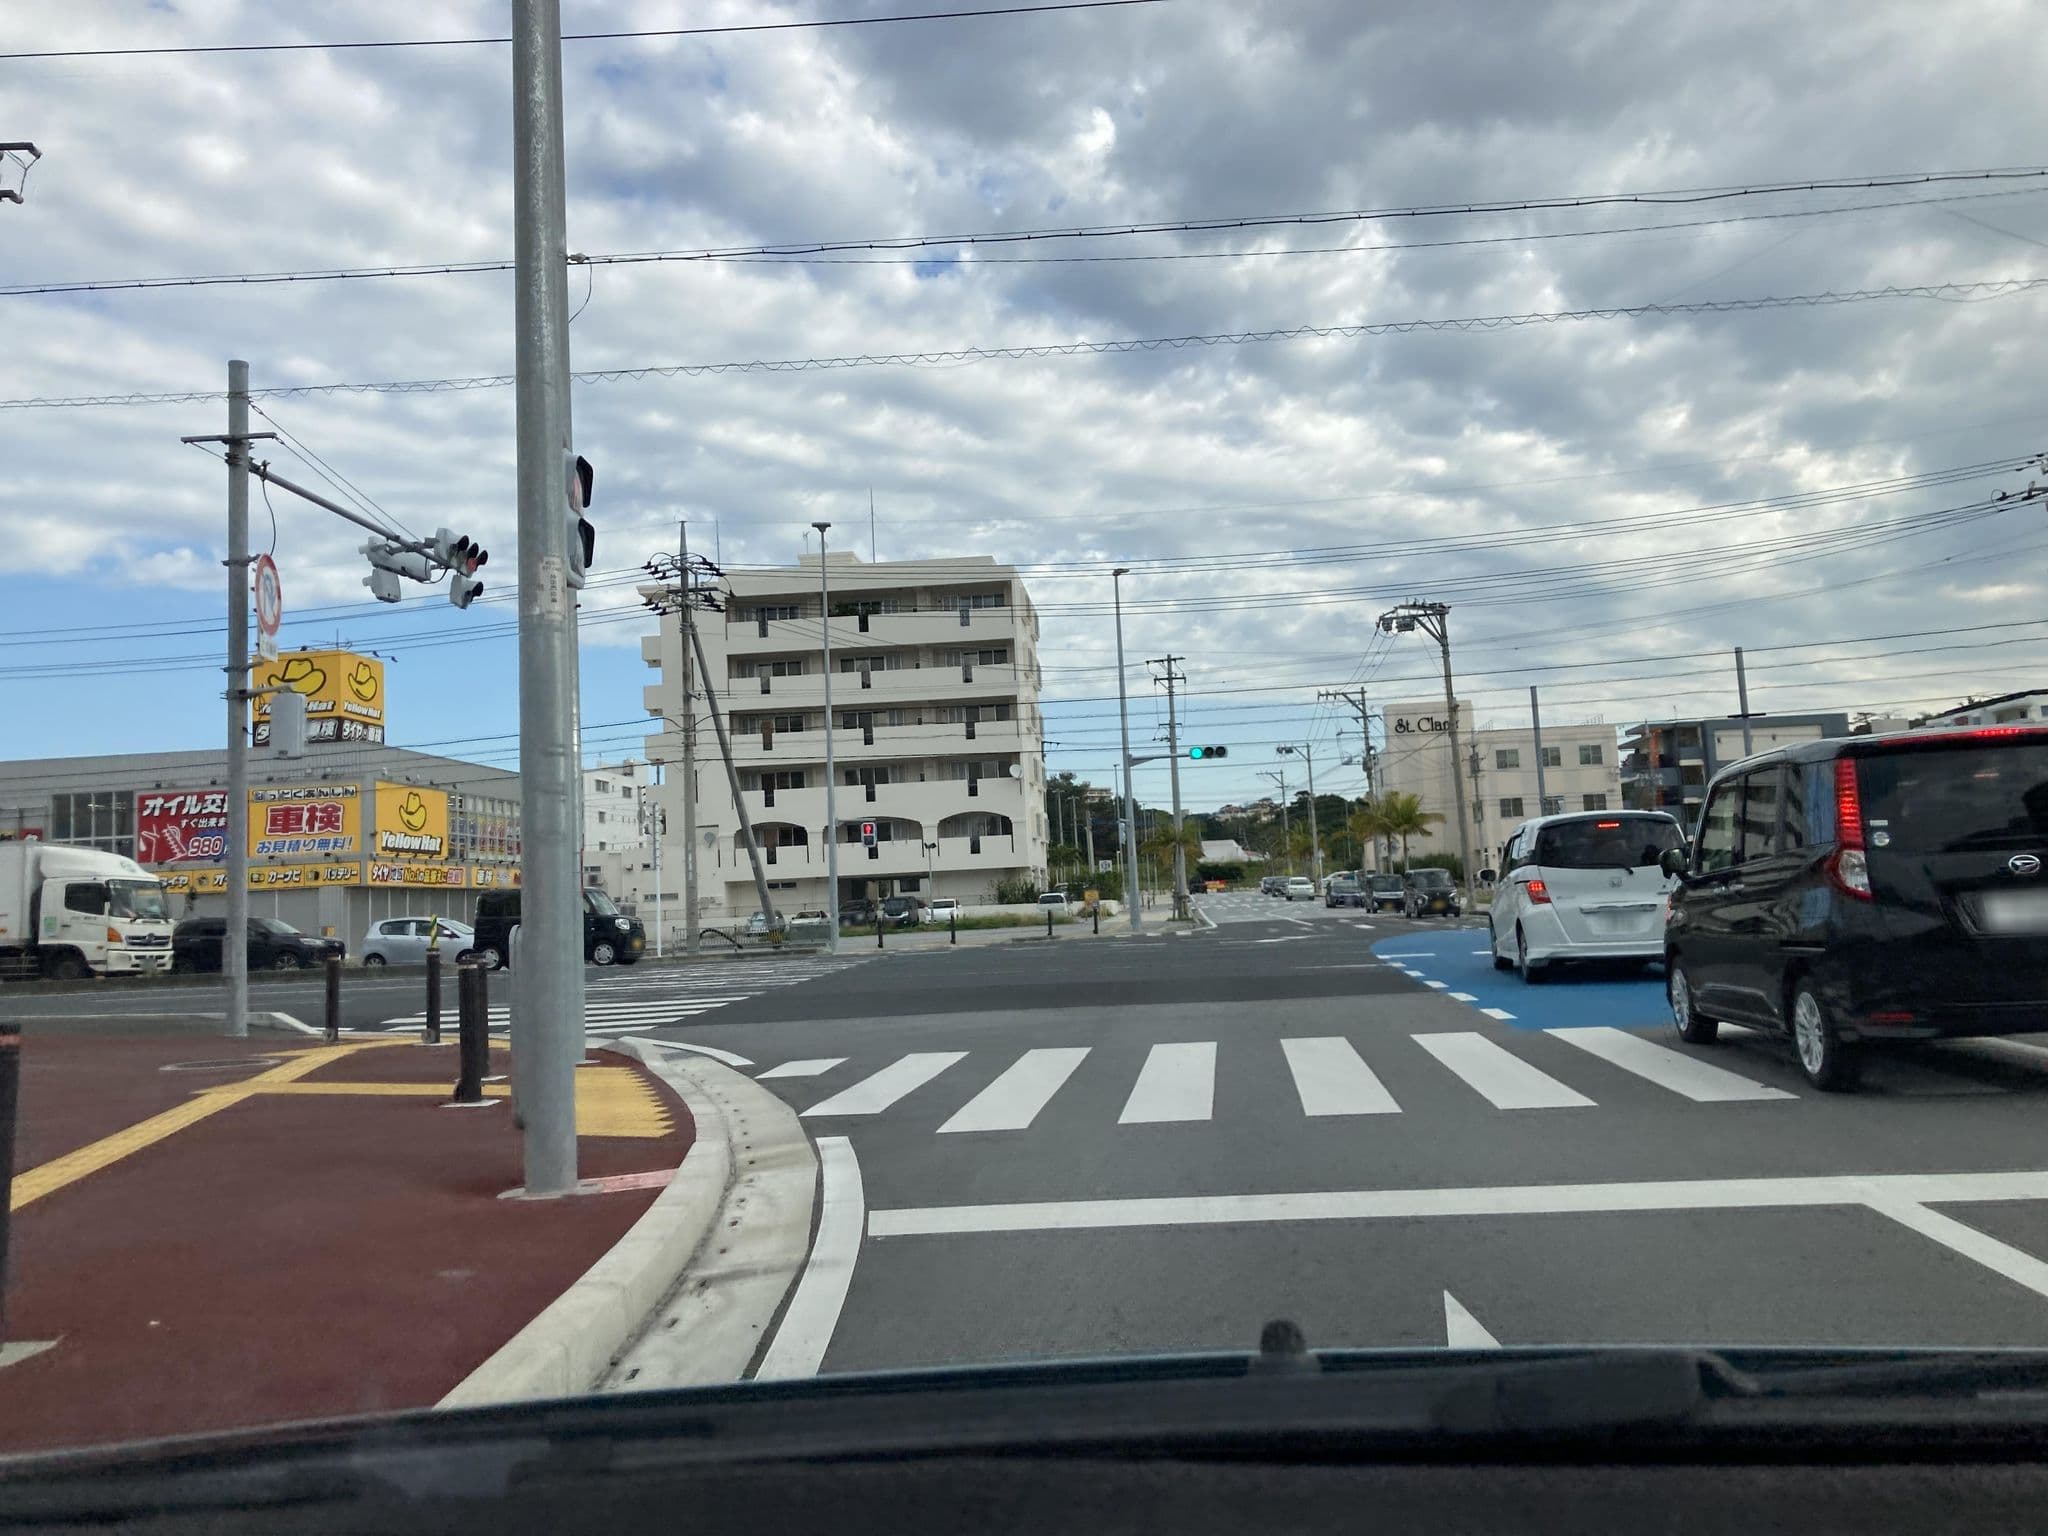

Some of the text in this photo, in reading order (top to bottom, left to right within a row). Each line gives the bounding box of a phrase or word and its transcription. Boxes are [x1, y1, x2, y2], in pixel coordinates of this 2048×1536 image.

[1394, 717, 1415, 733] St.
[142, 793, 228, 816] オイル交
[266, 802, 343, 835] 車検
